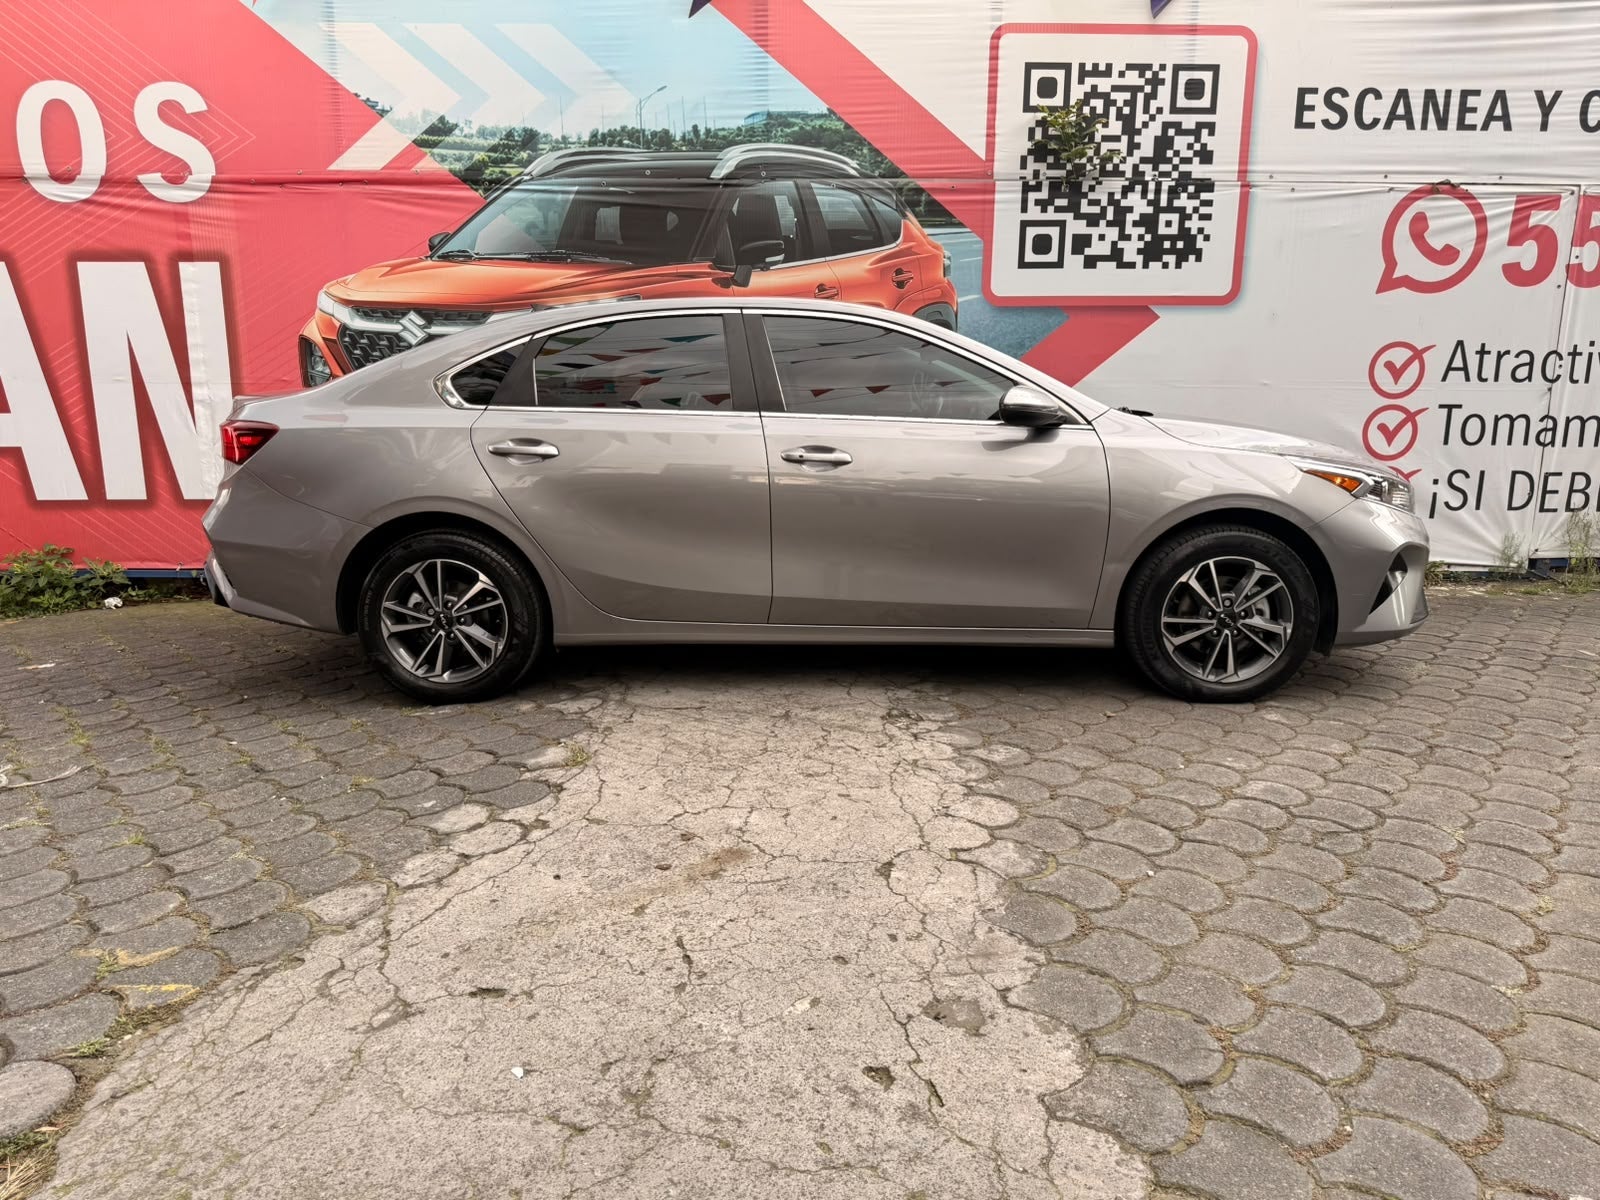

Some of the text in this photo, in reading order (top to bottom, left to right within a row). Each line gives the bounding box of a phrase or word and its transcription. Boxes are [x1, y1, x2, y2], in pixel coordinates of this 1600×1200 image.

[1294, 86, 1513, 132] ESCANEA
[1533, 89, 1564, 132] Y
[1501, 194, 1600, 288] 55
[1440, 339, 1600, 384] Atracti
[1438, 404, 1600, 448] Tomam
[1428, 469, 1600, 519] ¡SI DEB
